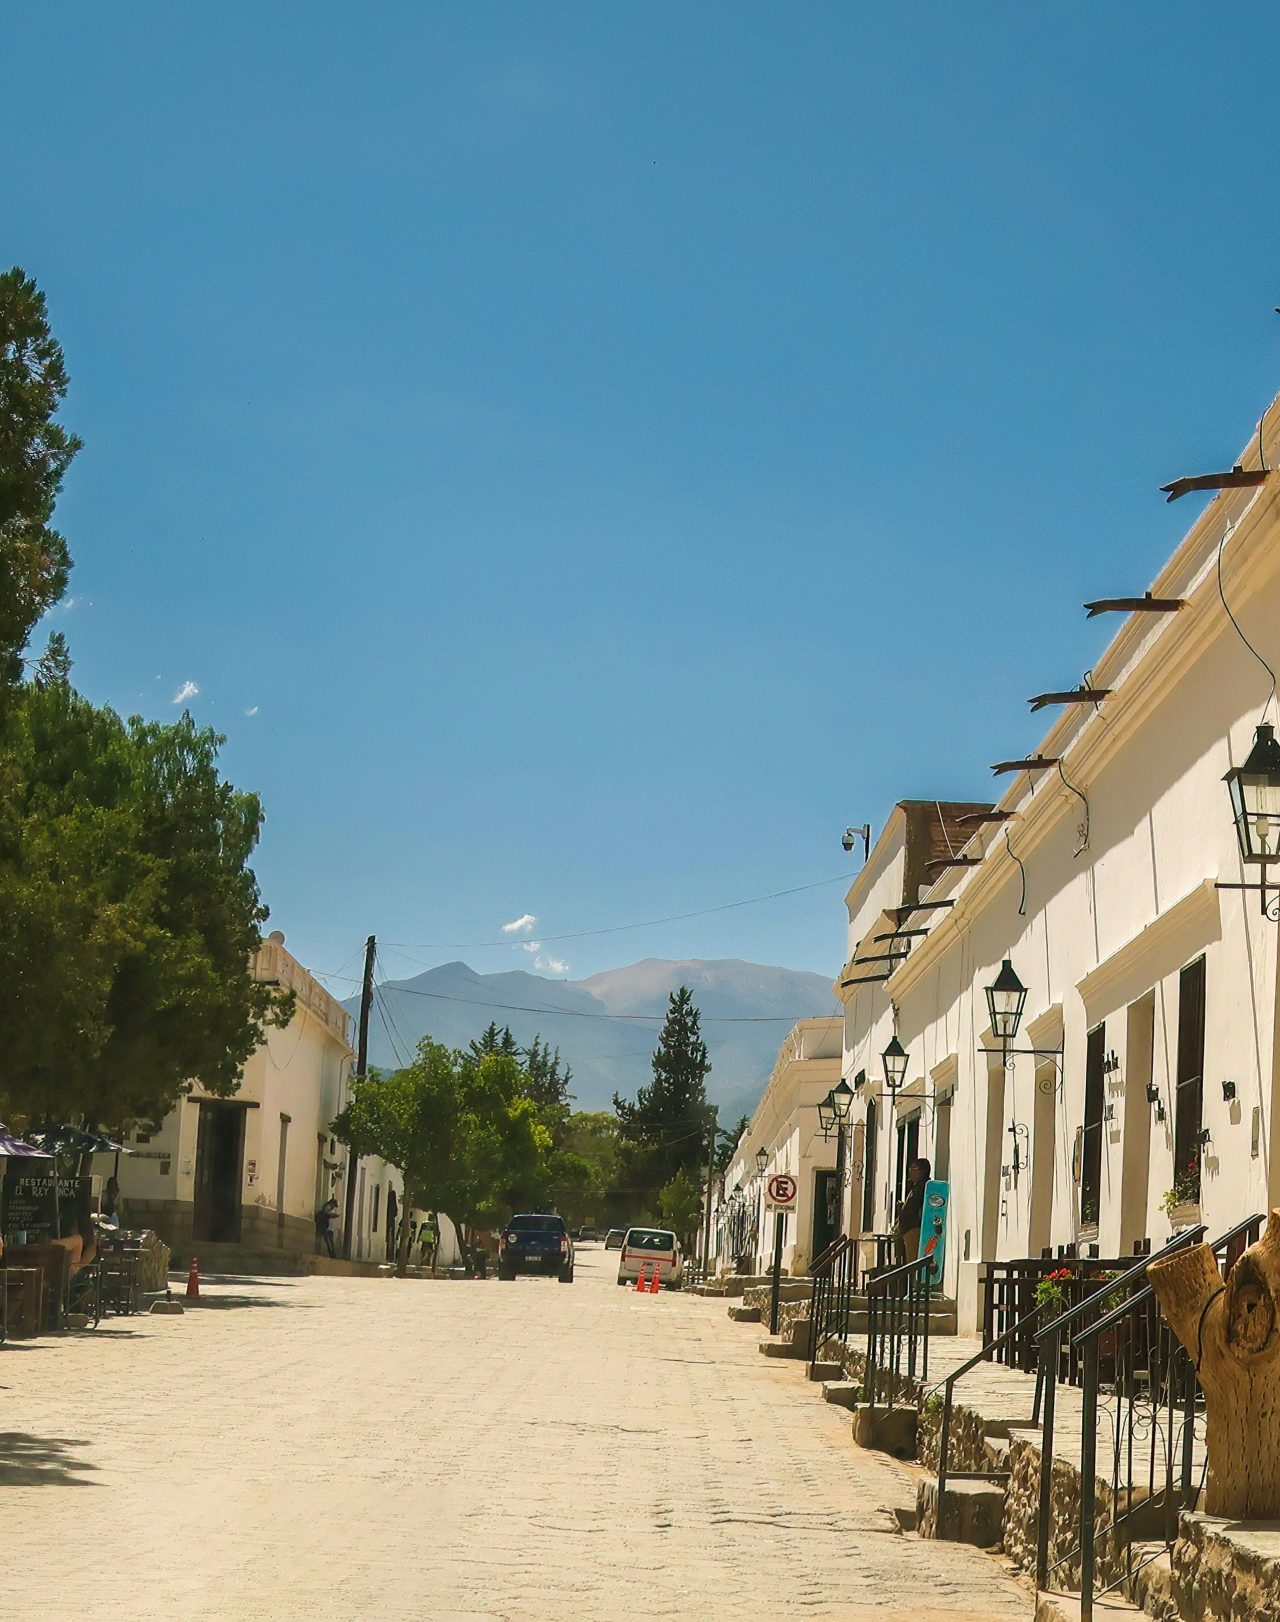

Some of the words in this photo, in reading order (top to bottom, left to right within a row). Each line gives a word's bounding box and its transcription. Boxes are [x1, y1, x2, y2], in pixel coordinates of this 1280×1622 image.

[19, 1178, 80, 1188] RESTAUANTE
[32, 1187, 49, 1197] REY
[776, 1181, 788, 1197] E
